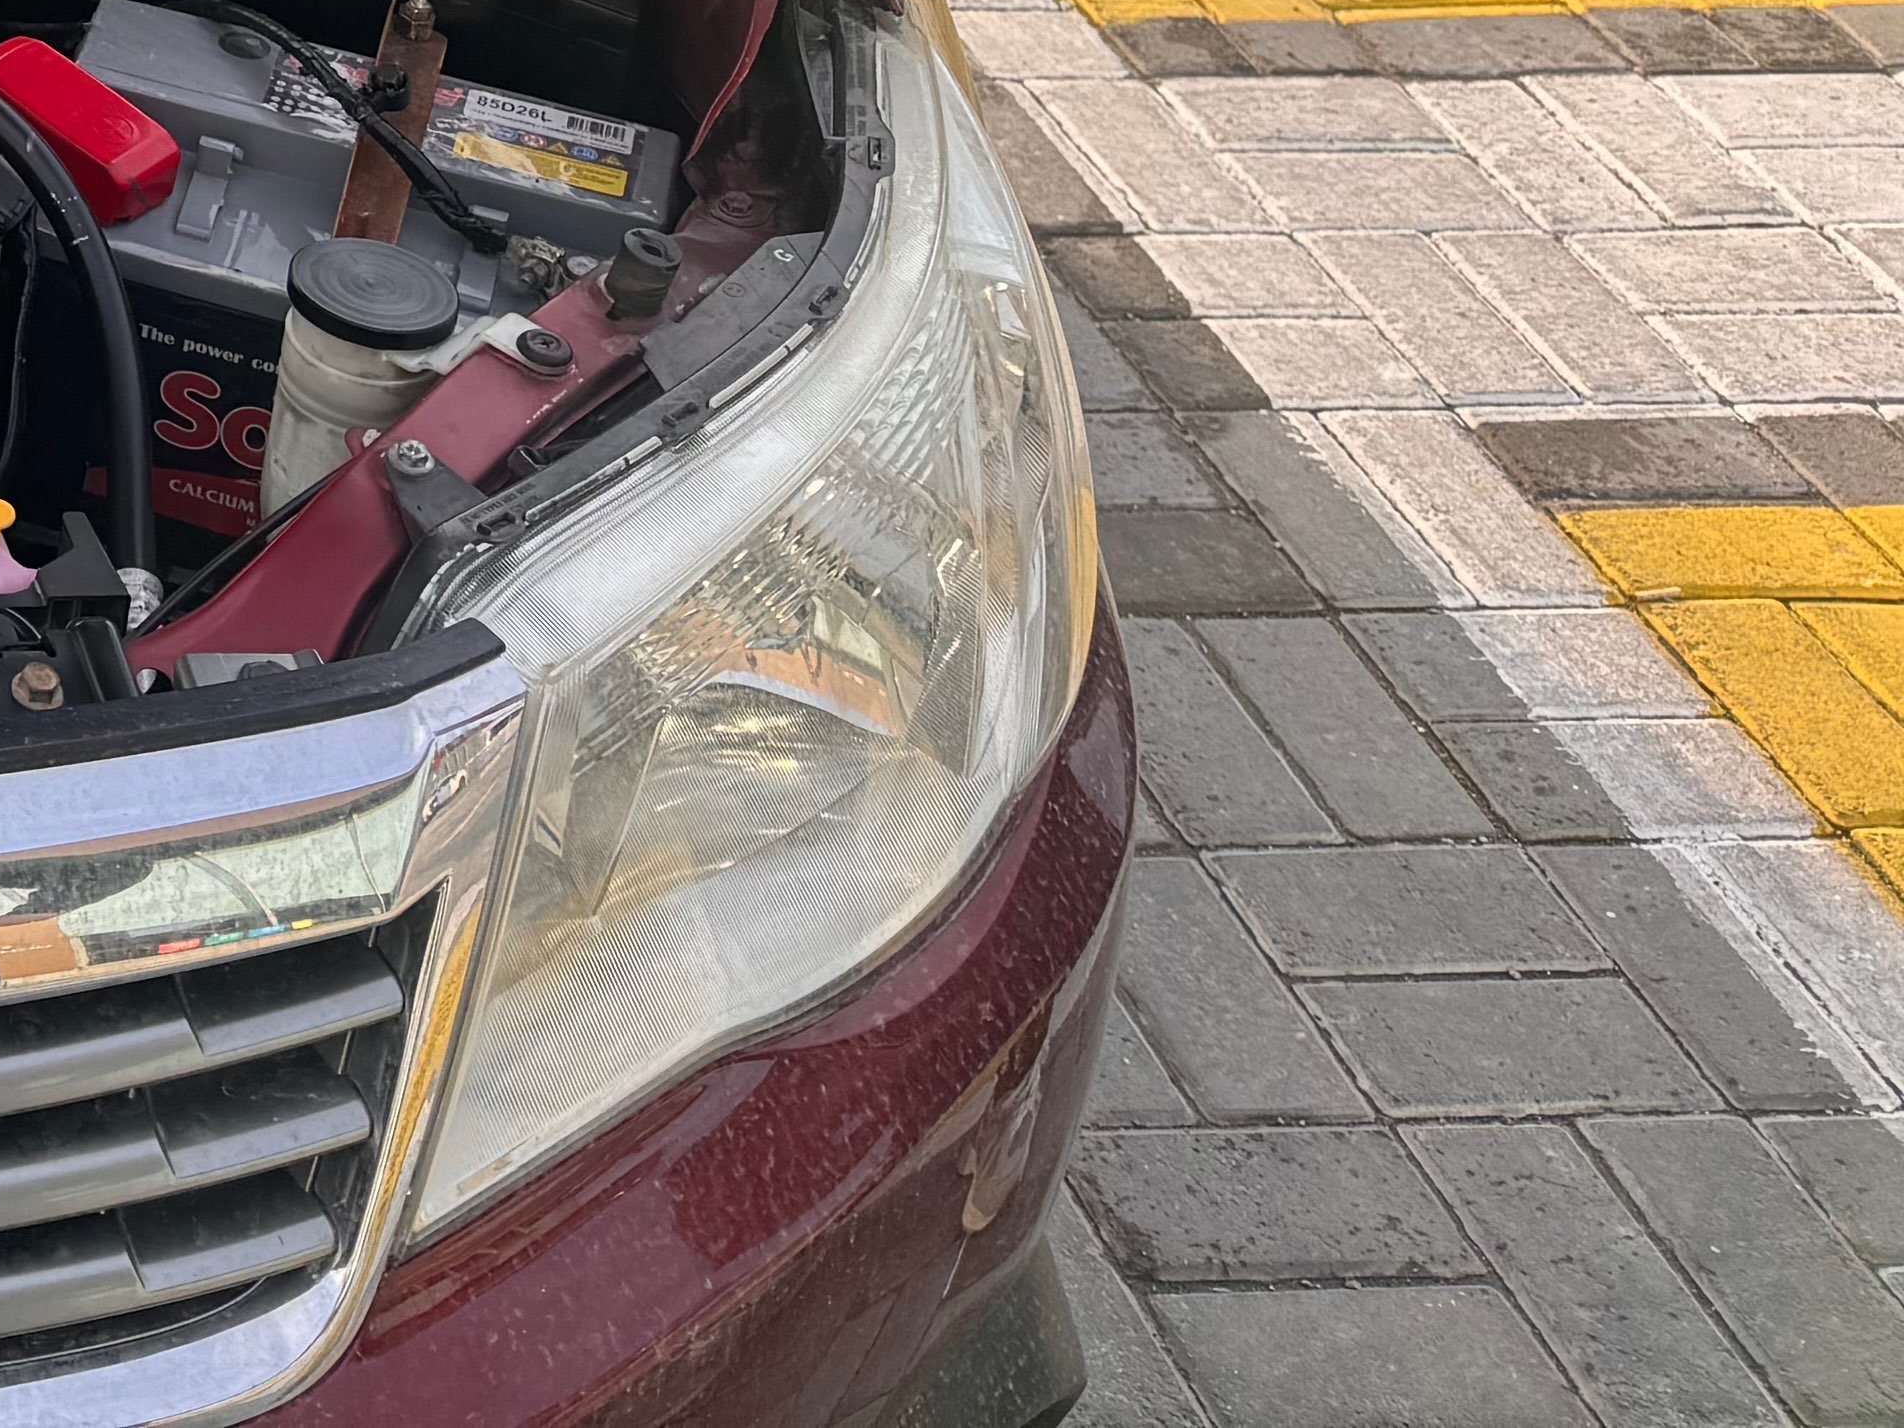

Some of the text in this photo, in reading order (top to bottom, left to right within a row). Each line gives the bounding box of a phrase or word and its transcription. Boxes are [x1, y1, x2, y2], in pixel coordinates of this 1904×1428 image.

[476, 95, 553, 123] 85D26L
[139, 322, 280, 375] The power co
[168, 478, 256, 514] CALCIUM
